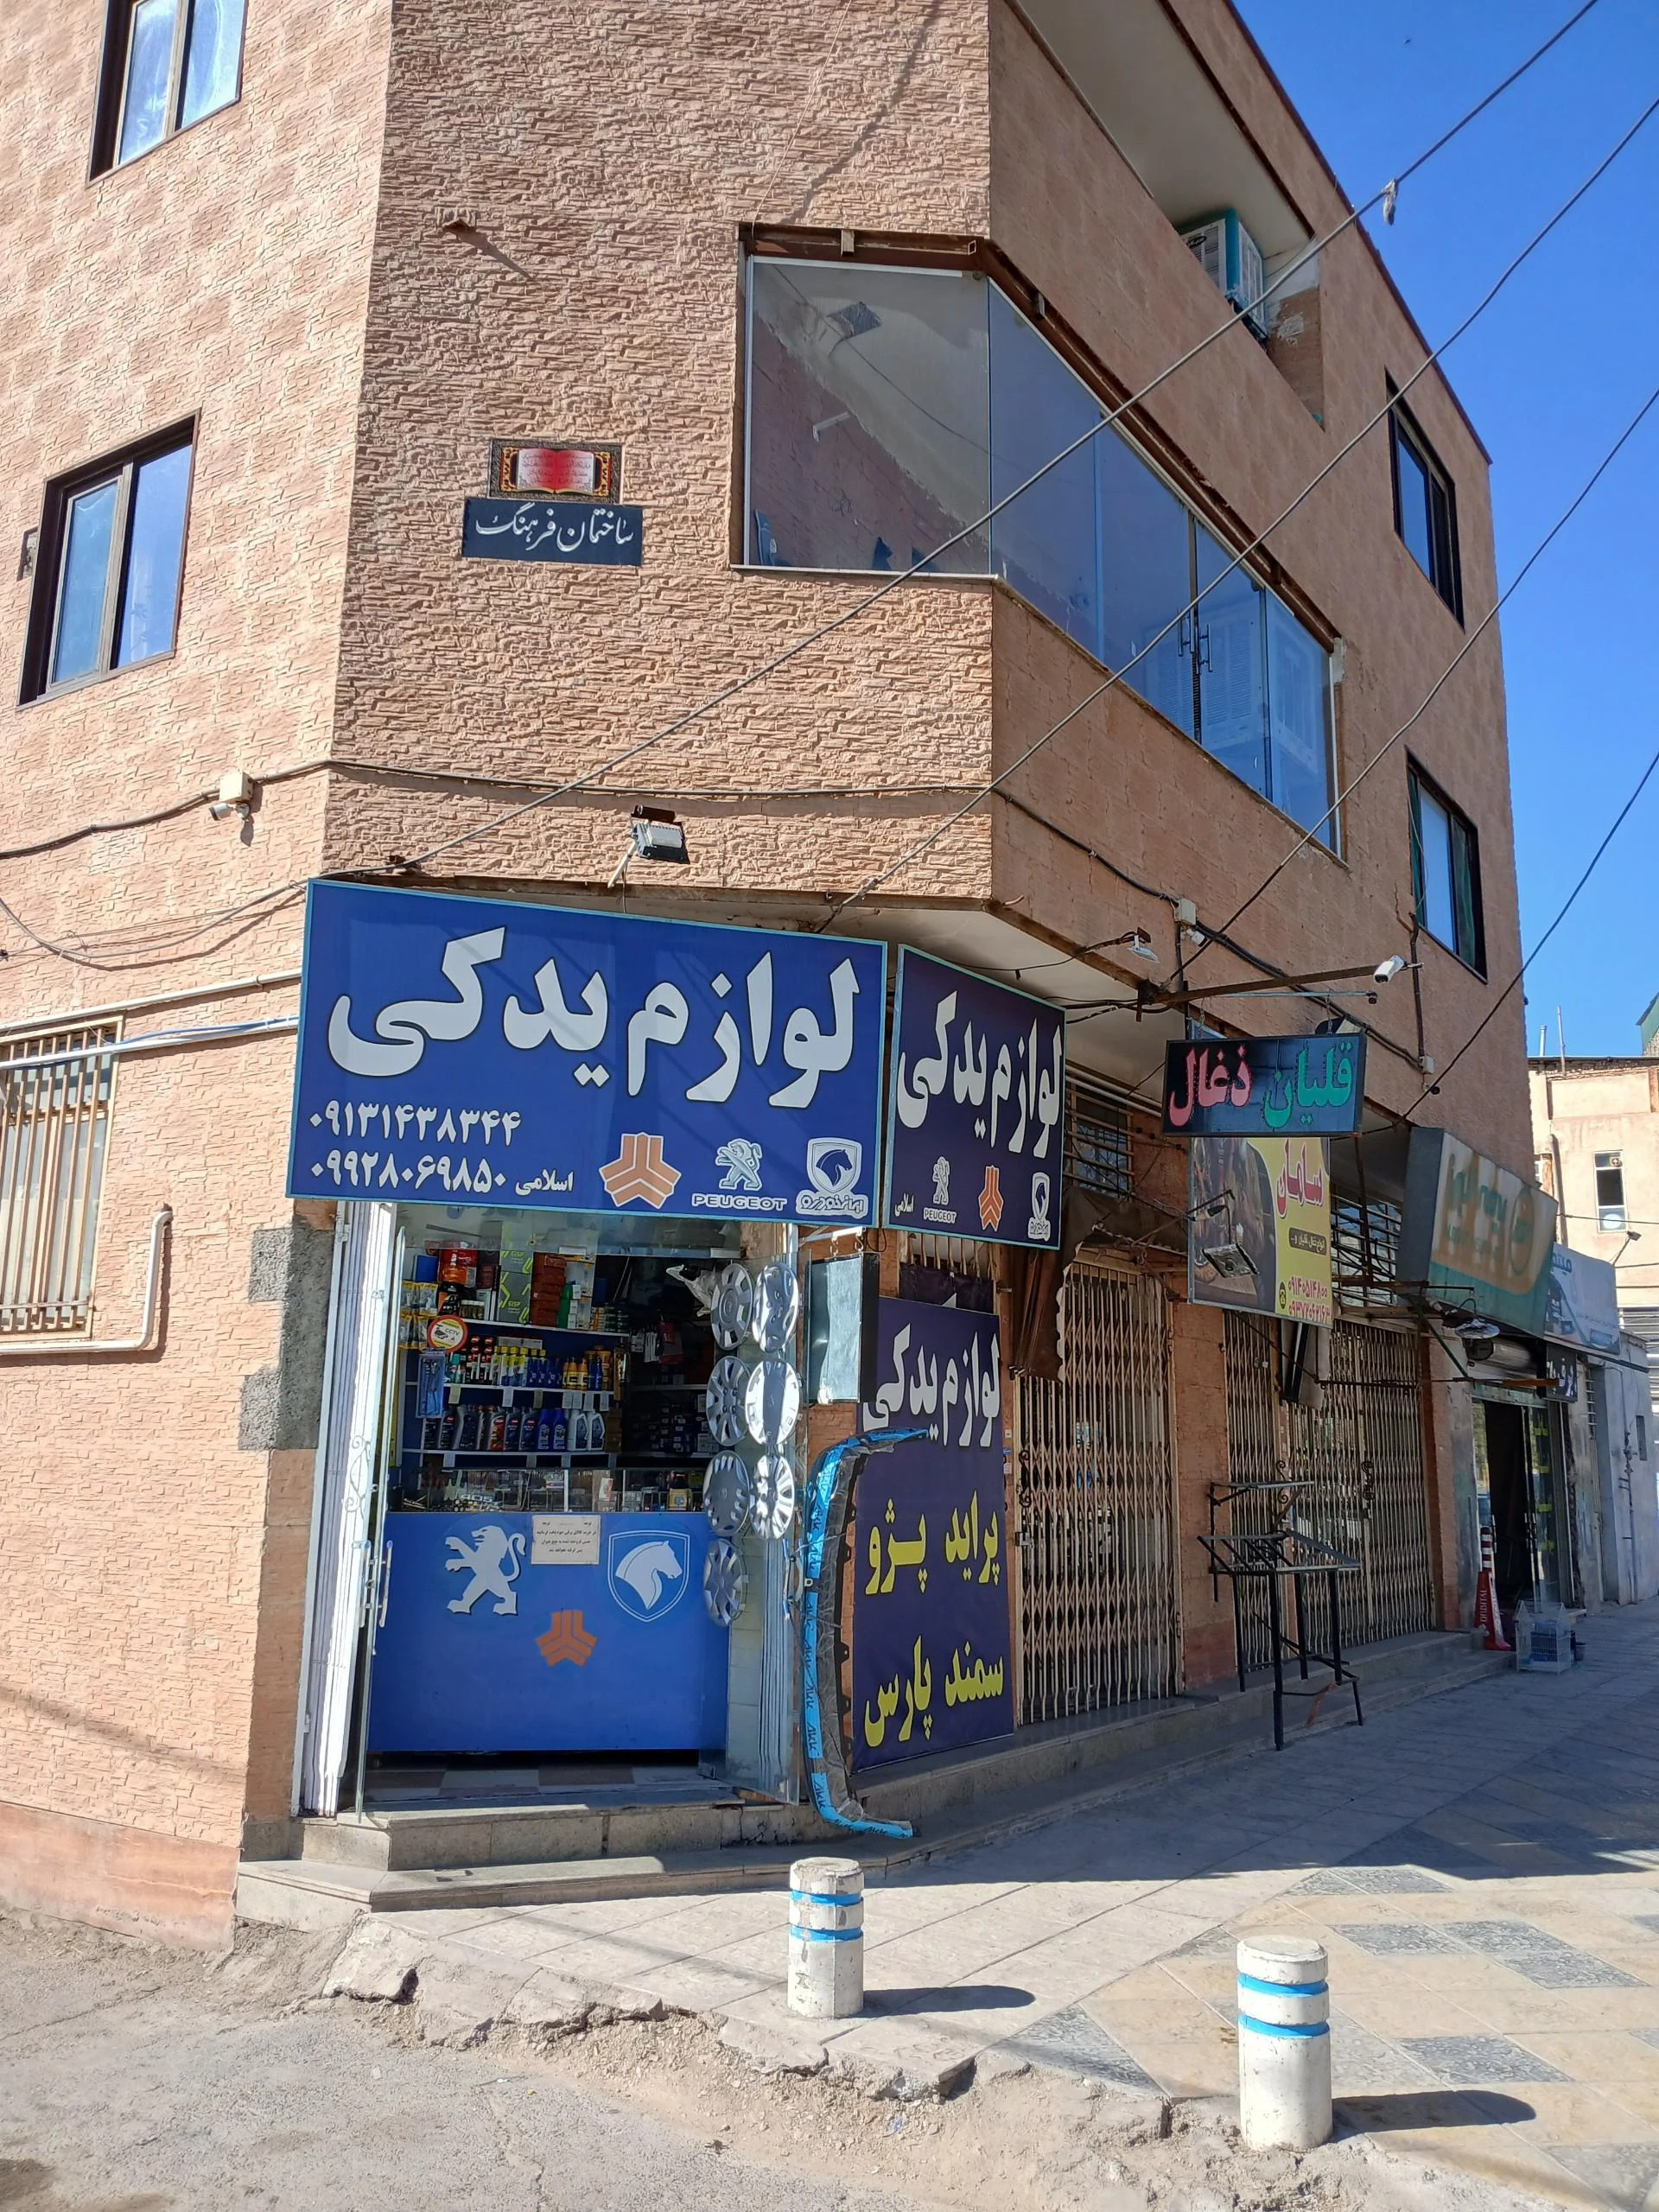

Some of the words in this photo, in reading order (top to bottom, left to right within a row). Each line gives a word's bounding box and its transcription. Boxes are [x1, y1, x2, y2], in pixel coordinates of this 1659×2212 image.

[475, 502, 556, 550] فرهنگ
[556, 508, 633, 552] ساختمان
[327, 926, 610, 1087] یدکی
[627, 951, 860, 1109] لوازم
[897, 990, 986, 1140] یدکی
[990, 1017, 1062, 1159] لوازم
[1168, 1044, 1253, 1127] ذغال
[1263, 1042, 1354, 1128] قلیان
[309, 1100, 521, 1147] ۰۹۱۳۱۴۳۸۳۴۴
[311, 1149, 506, 1194] ۰۹۹۲۸۰۶۹۸۵۰
[515, 1168, 574, 1196] اسلامی
[692, 1192, 787, 1211] PEUGEOT
[925, 1207, 957, 1224] PEUGEOT
[863, 1322, 939, 1442] یدکی
[942, 1332, 1001, 1446] لوازم
[866, 1498, 927, 1594] پژو
[945, 1491, 1000, 1587] پراید
[864, 1634, 932, 1747] پارس
[945, 1641, 1004, 1707] سمند
